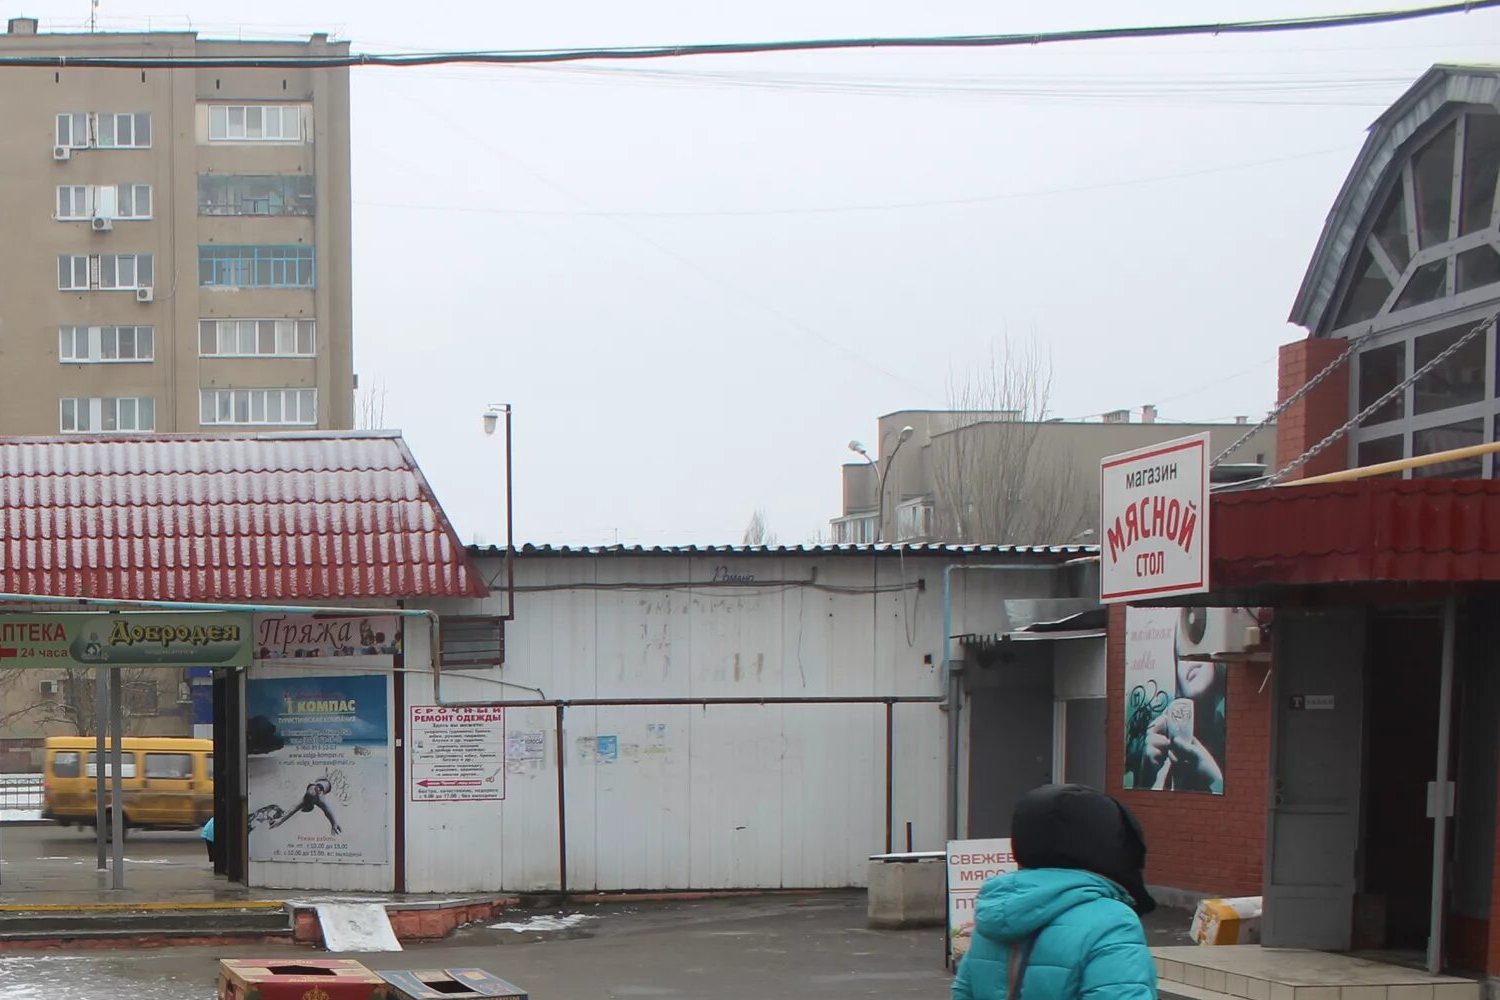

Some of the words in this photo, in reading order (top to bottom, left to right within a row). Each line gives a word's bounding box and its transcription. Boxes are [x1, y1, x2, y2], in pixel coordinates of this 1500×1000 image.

[1126, 463, 1177, 489] магазин
[1107, 496, 1197, 564] МЯСНОЙ
[1136, 551, 1164, 577] СТОЛ
[258, 615, 352, 654] Пряжа
[21, 648, 35, 658] 24
[39, 649, 68, 658] часа
[298, 700, 356, 713] КОМПАС
